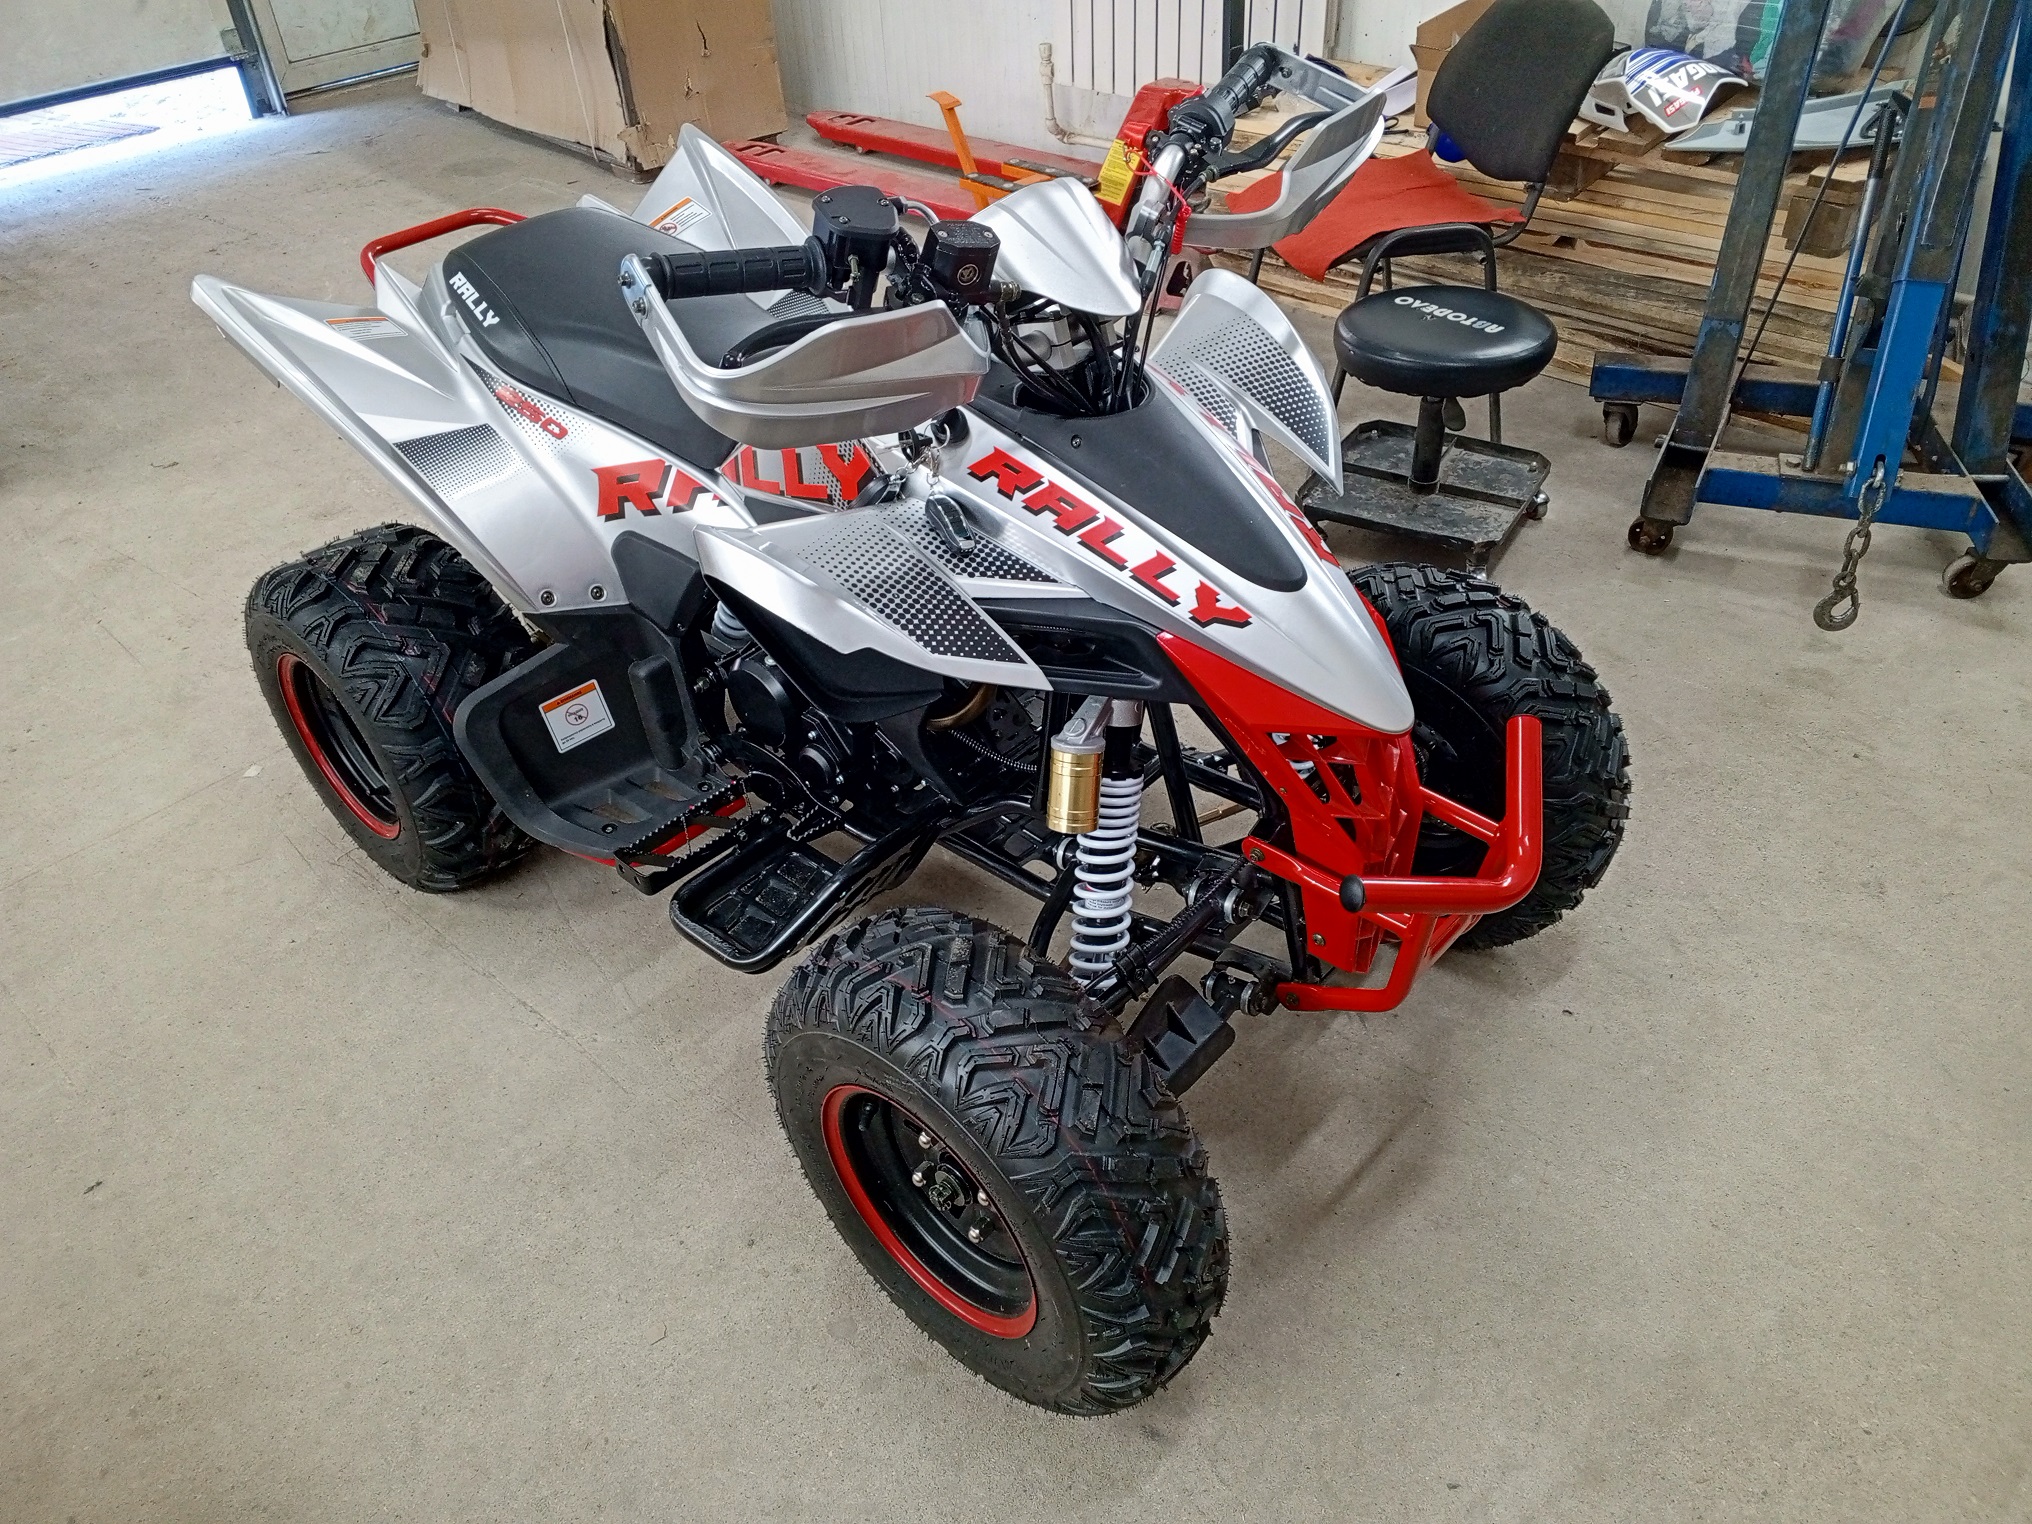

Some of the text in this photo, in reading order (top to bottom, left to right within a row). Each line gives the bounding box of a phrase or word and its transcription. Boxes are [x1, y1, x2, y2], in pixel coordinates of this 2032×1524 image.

[1665, 86, 1702, 116] PGASI
[449, 272, 500, 327] RALLY
[591, 443, 873, 522] RALLY
[967, 446, 1253, 629] RALLY
